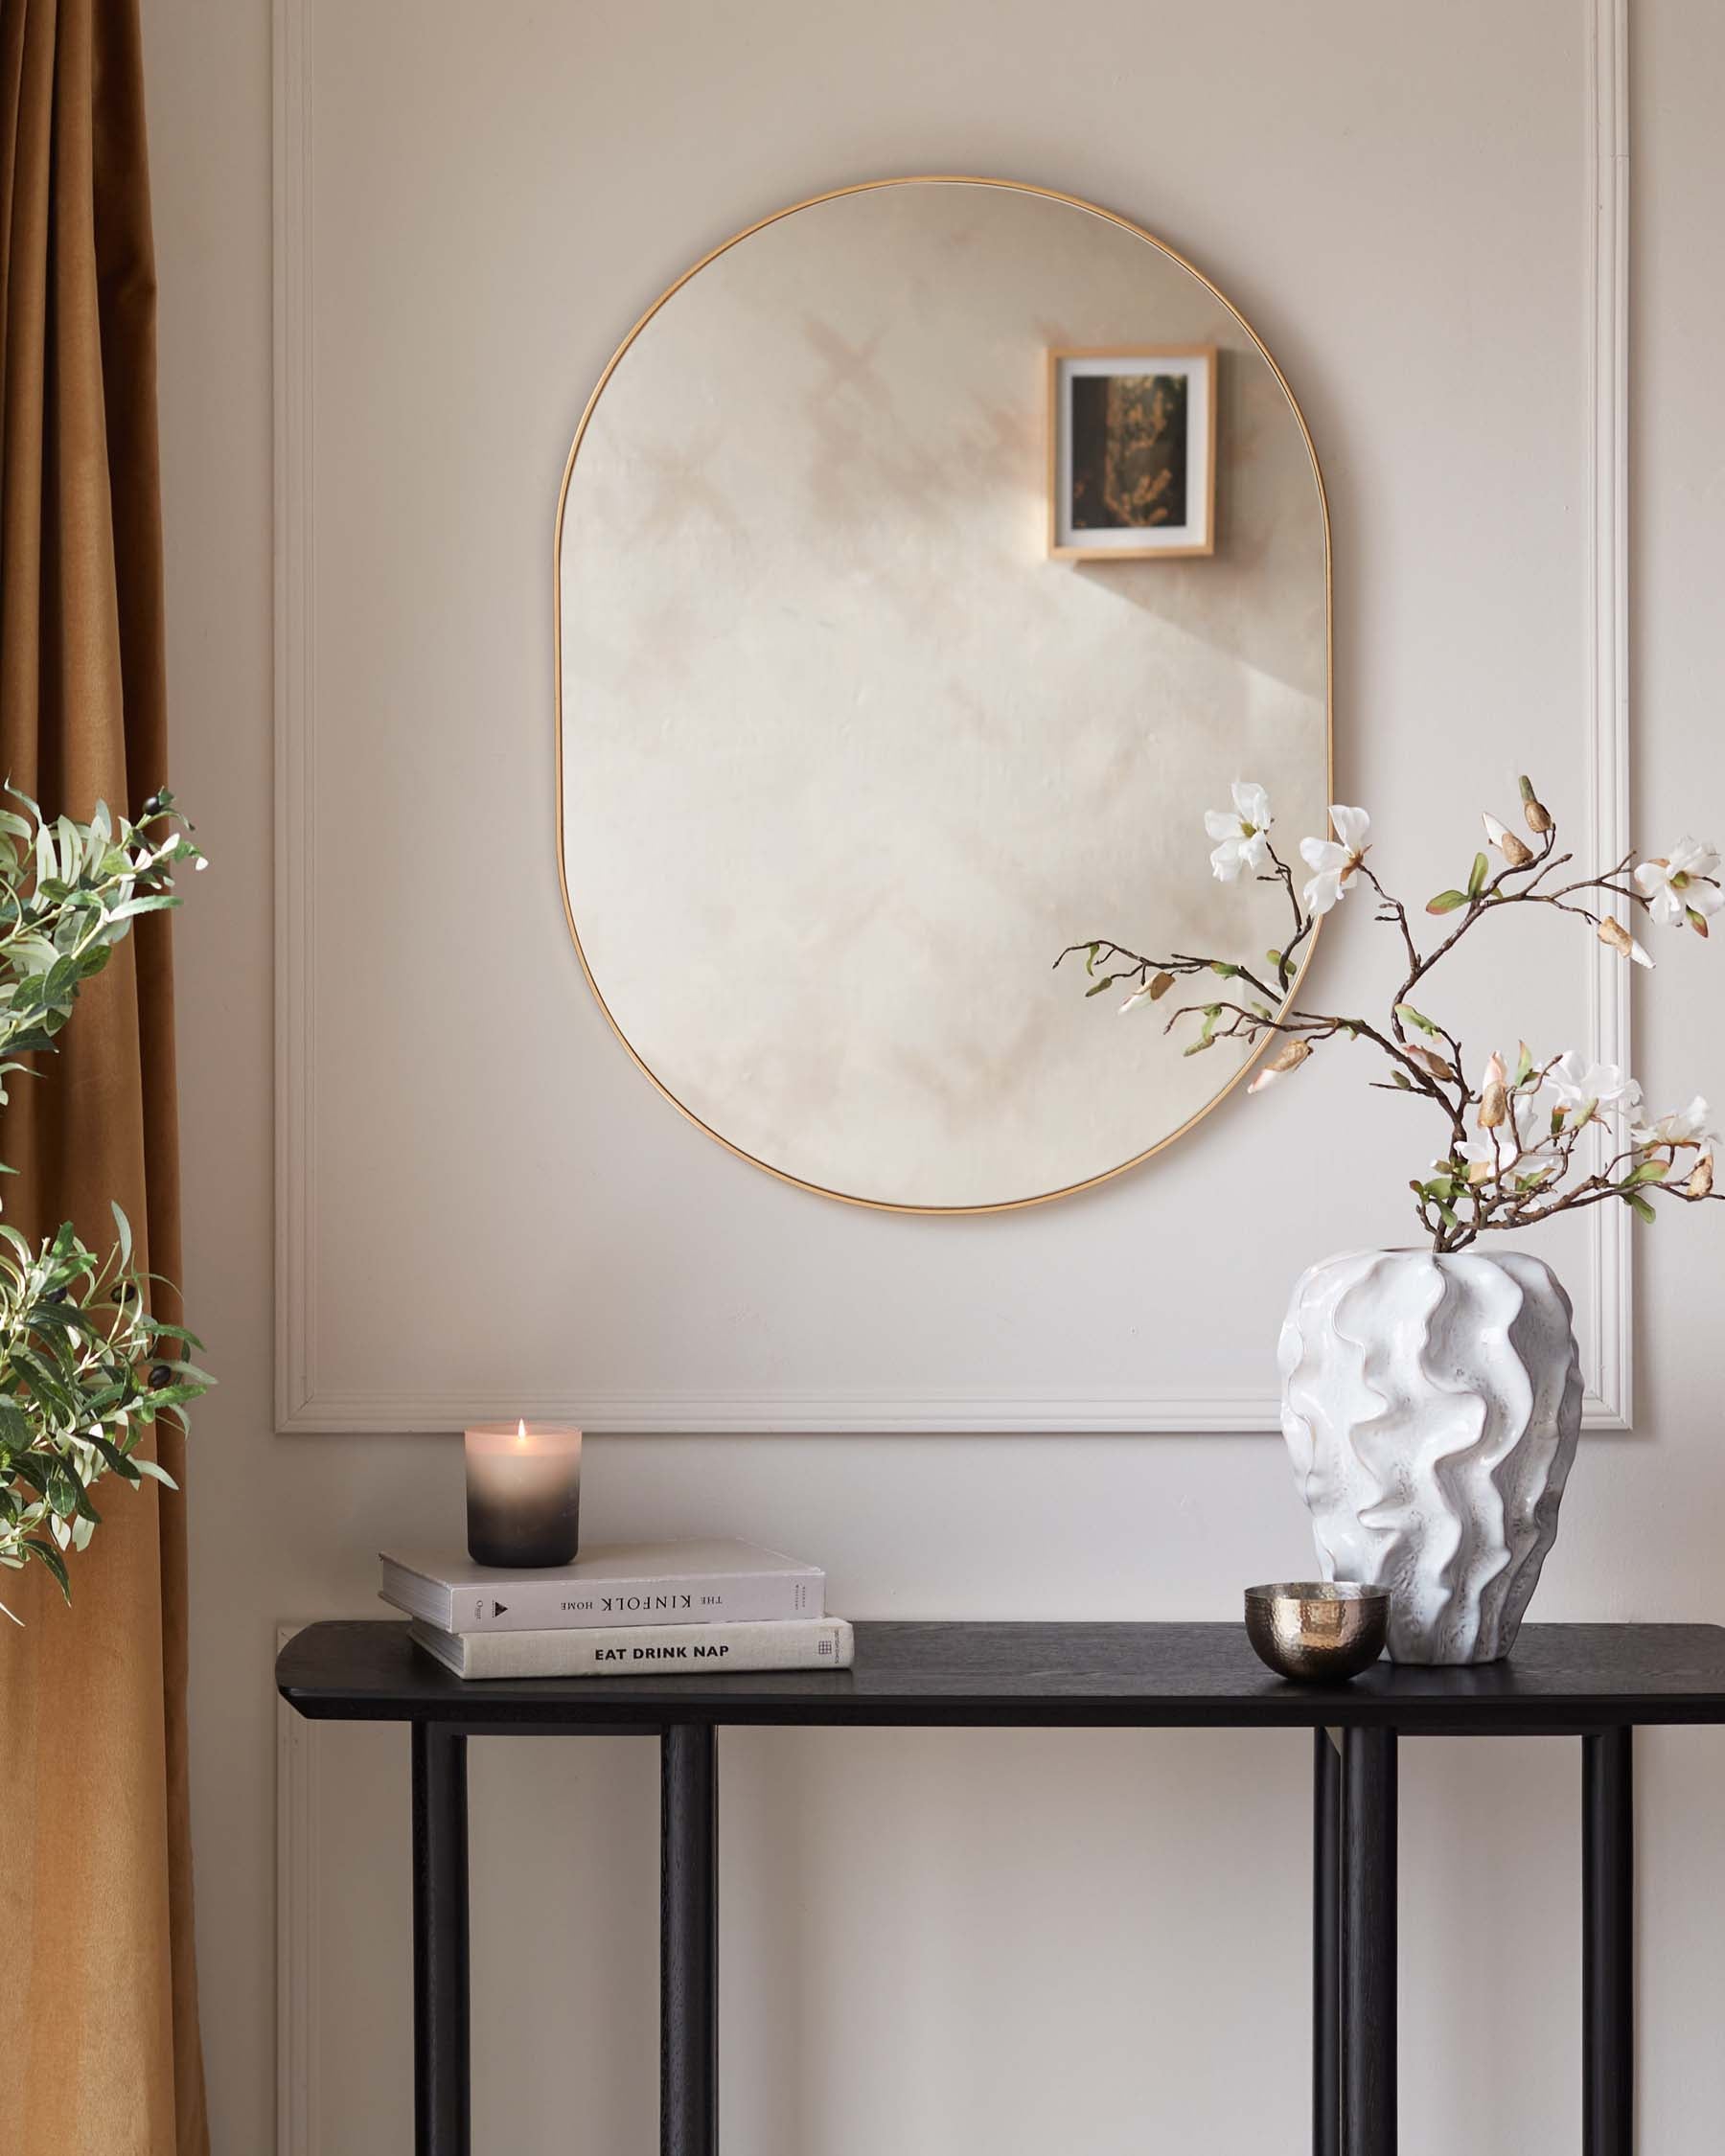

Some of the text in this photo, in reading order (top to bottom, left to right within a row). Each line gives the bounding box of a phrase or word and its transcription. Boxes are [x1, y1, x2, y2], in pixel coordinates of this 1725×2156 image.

[560, 1594, 723, 1612] THE KINFOLK HOME
[595, 1644, 729, 1661] EAT DRINK NAP
